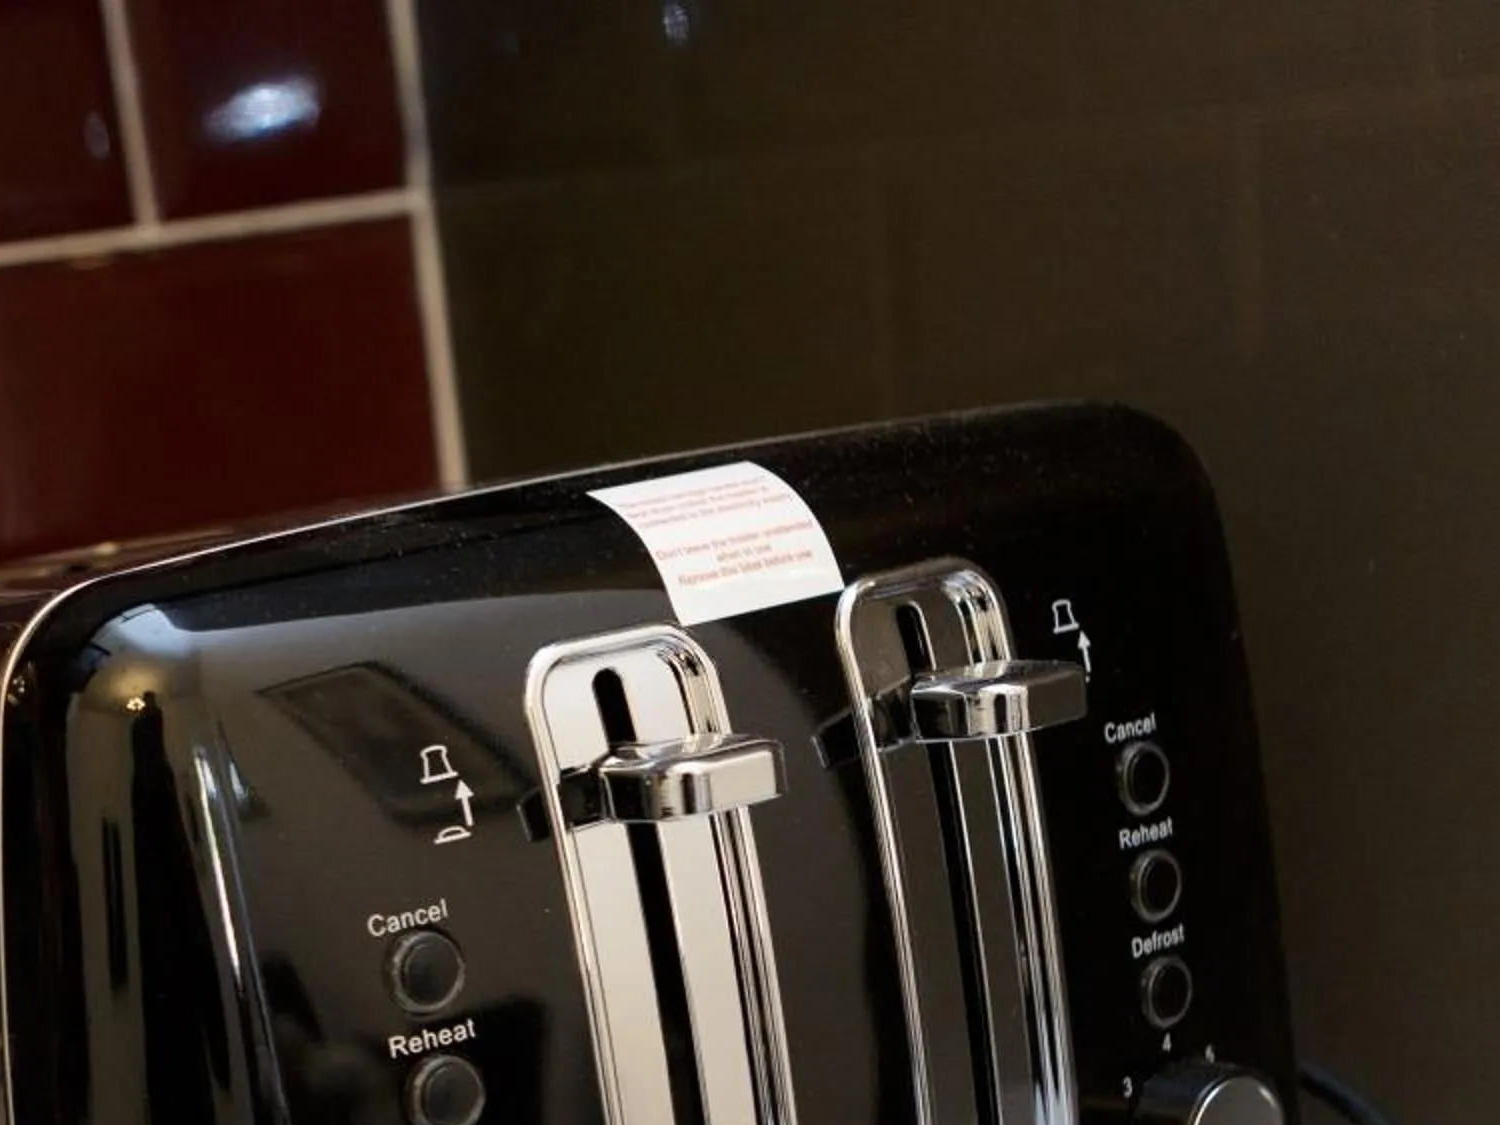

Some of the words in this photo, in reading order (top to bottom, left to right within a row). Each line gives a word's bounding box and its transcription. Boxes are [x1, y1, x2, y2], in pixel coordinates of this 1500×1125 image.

[1103, 711, 1158, 744] Cancel
[1119, 815, 1174, 849] Reheat
[366, 898, 449, 938] Cancel
[1131, 922, 1185, 959] Defrost
[387, 1018, 477, 1060] Reheat
[1161, 1031, 1172, 1052] 4
[1122, 1075, 1134, 1099] 3
